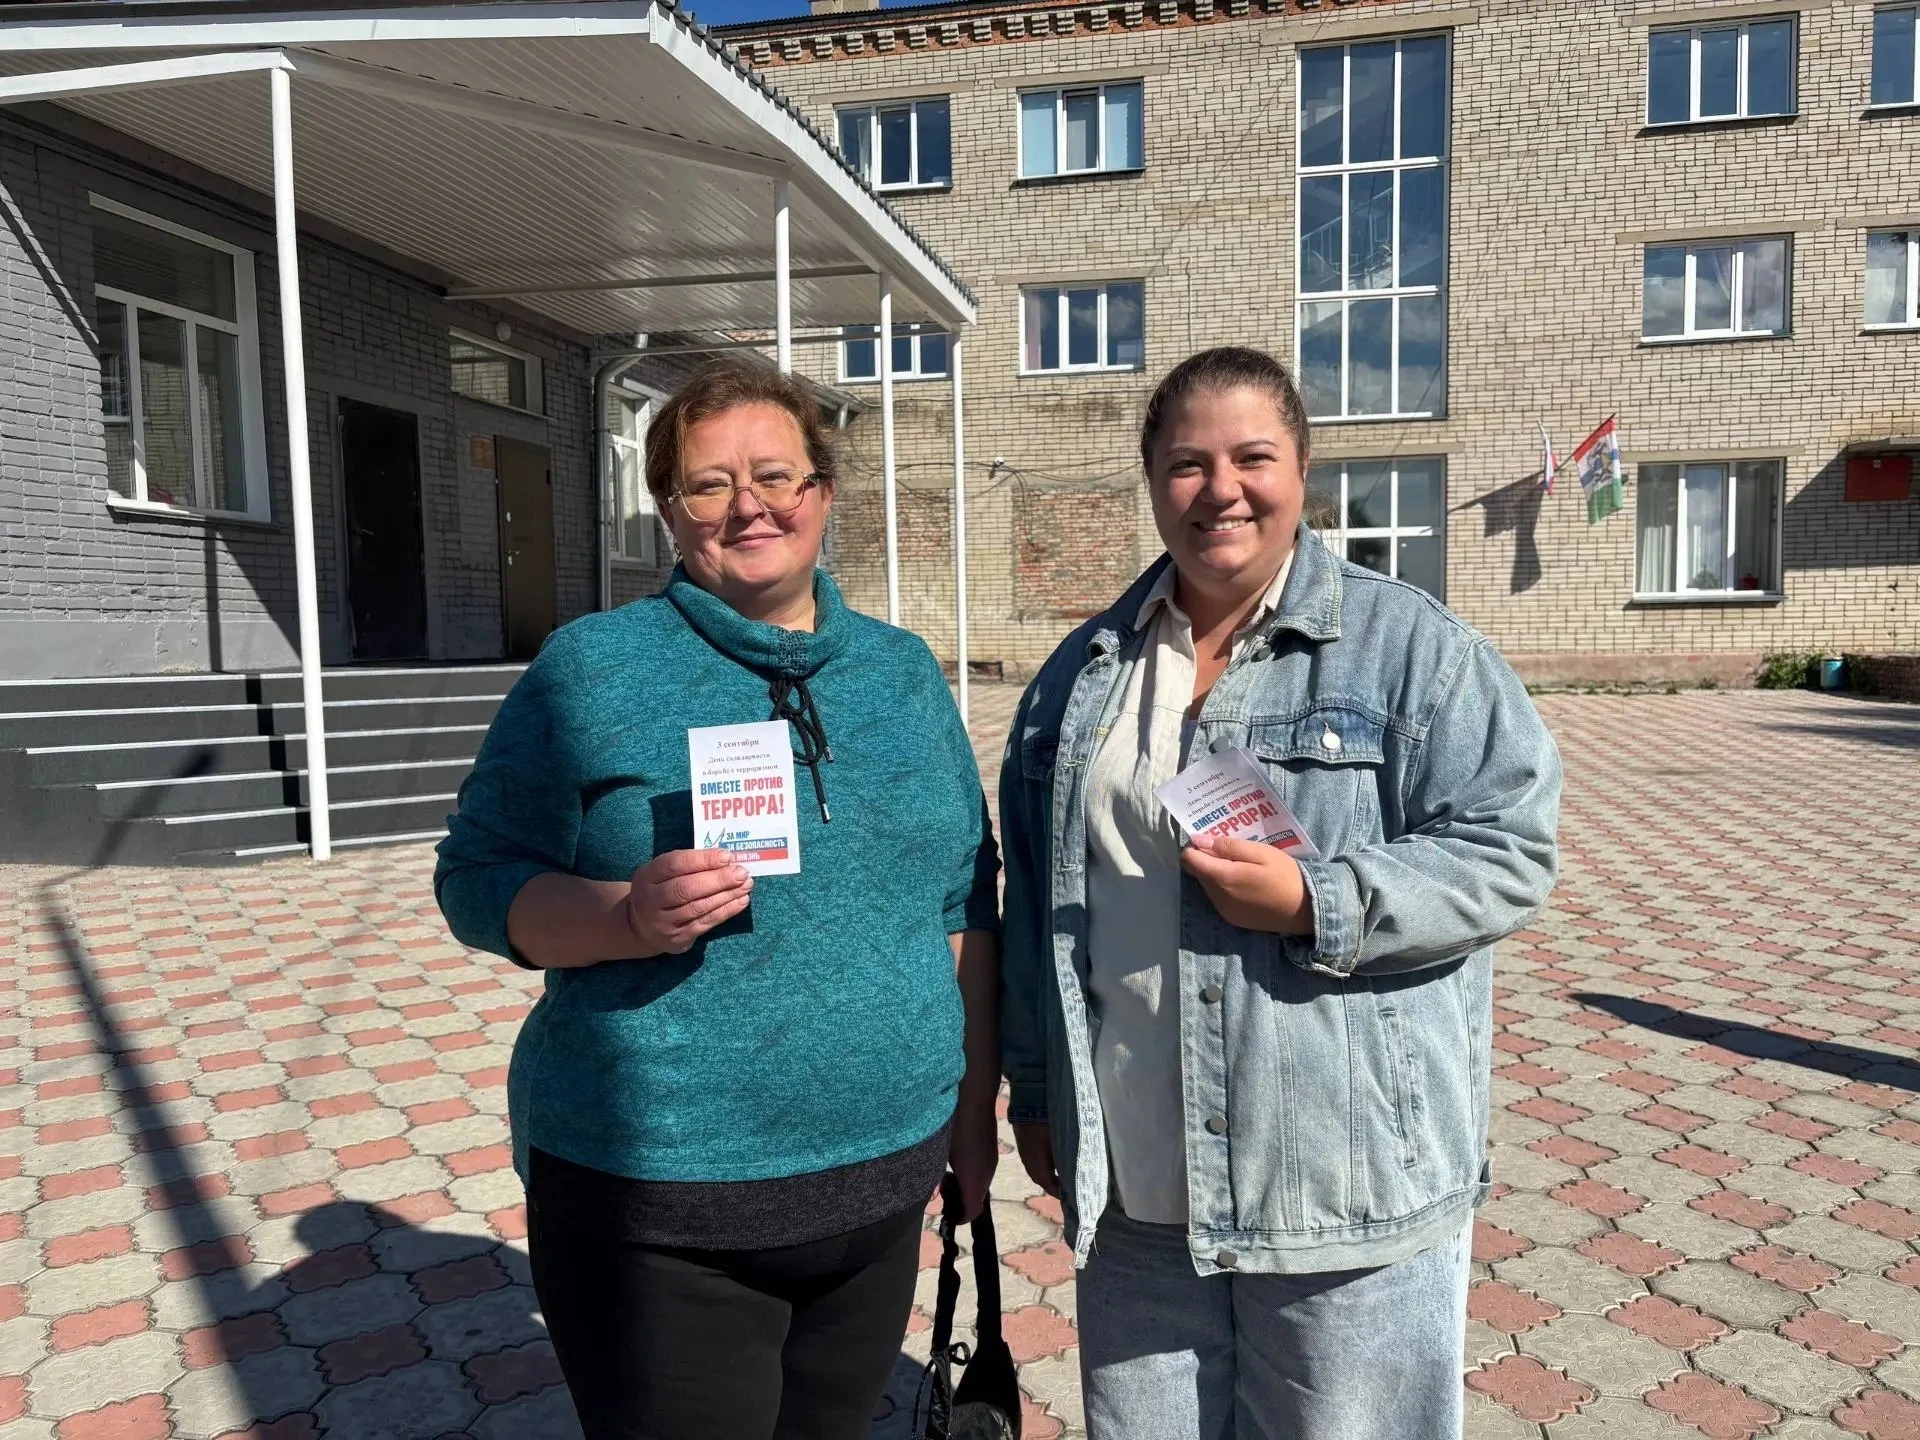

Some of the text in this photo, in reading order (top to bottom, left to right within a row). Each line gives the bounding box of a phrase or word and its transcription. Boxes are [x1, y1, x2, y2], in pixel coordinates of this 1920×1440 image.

[717, 738, 760, 749] 3 сентября
[700, 776, 784, 796] ВМЕСТЕ ПРОТИВ
[1193, 771, 1225, 791] сентября
[701, 793, 785, 821] ТЕРРОРА!
[1192, 789, 1266, 832] ВМЕСТЕ ПРОТИВ
[1203, 801, 1279, 839] ЕРРОРА!
[726, 831, 750, 841] ЗА МИР
[736, 839, 786, 851] БЕЗОПАСНОСТЬ
